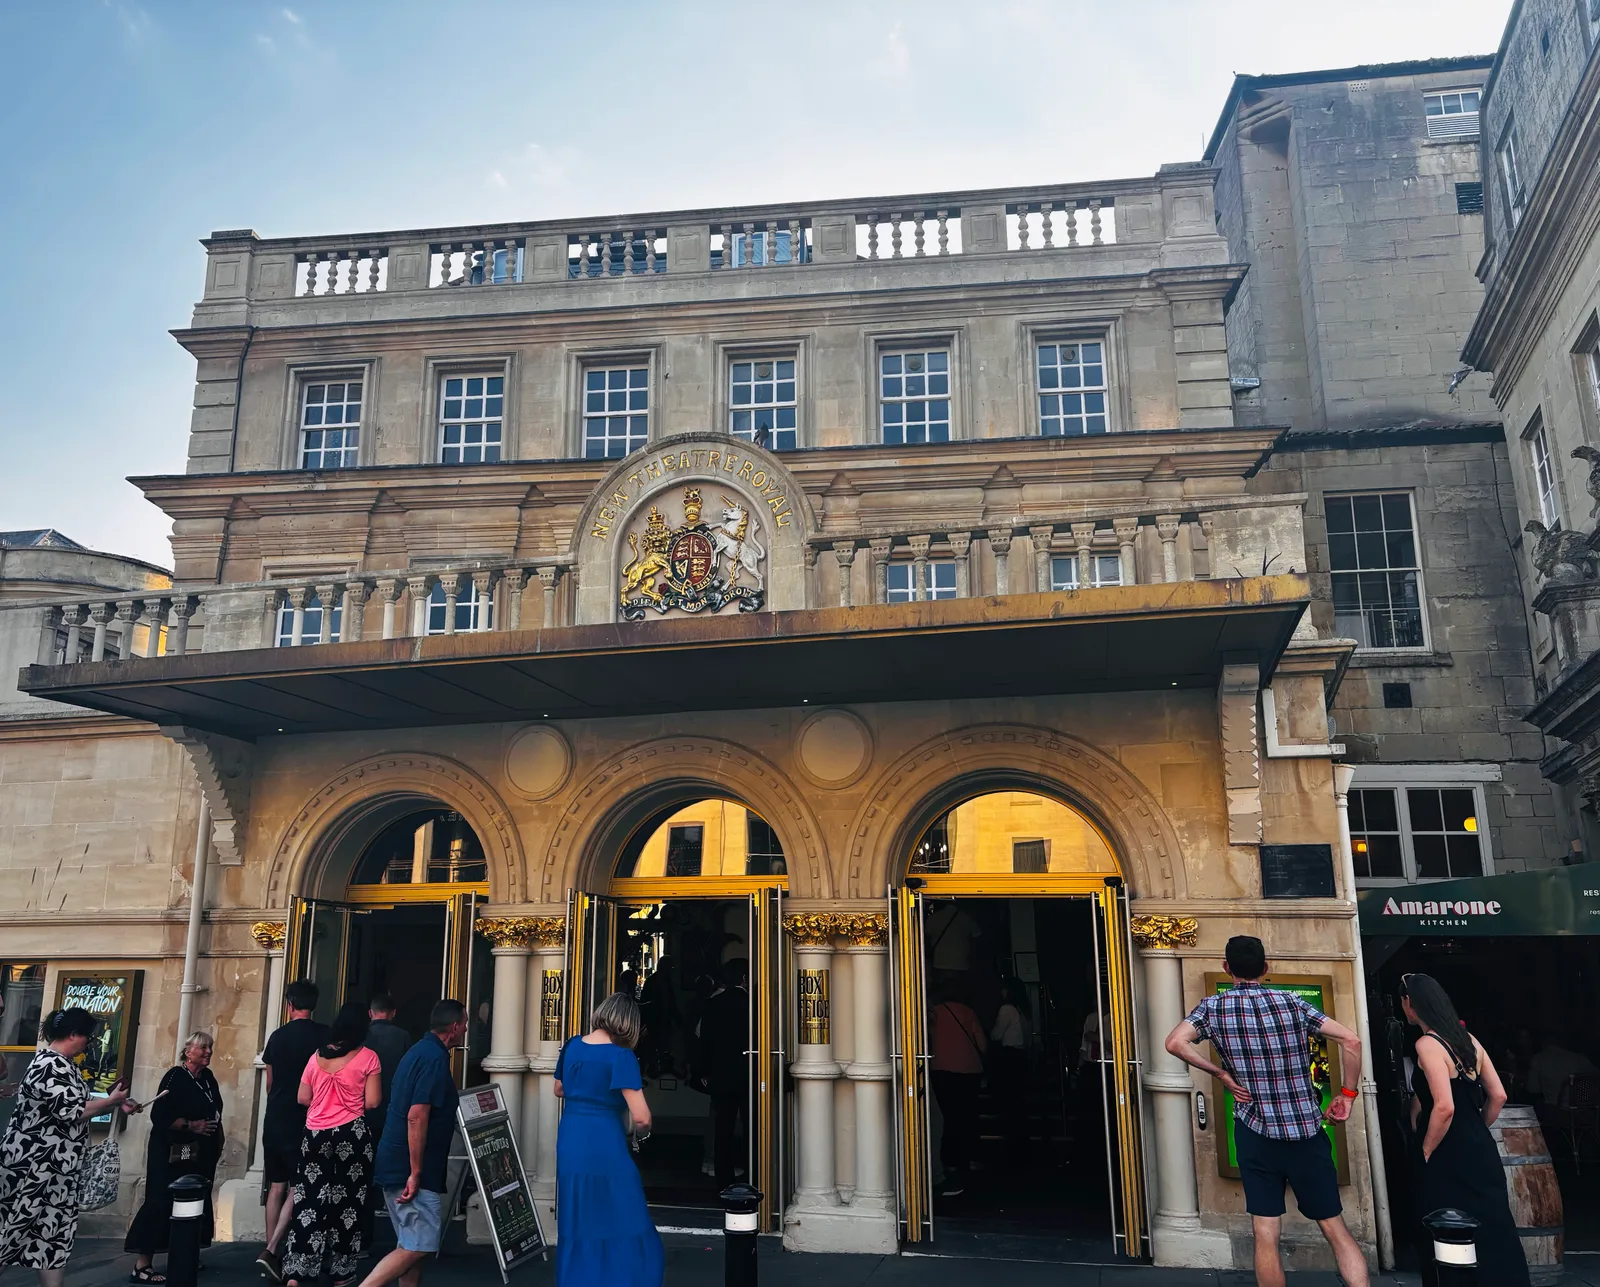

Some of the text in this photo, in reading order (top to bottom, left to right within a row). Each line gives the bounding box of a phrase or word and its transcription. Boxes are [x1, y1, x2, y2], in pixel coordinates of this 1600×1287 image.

[591, 450, 794, 540] NEW THEATRE ROYAL
[669, 598, 684, 606] ET
[686, 597, 707, 610] MON
[724, 588, 755, 602] DROIT
[1381, 897, 1502, 915] Amarone
[66, 984, 120, 997] DOUBLE YOUR
[543, 976, 563, 994] BOX
[800, 976, 823, 994] BOX
[63, 995, 121, 1014] DONATION
